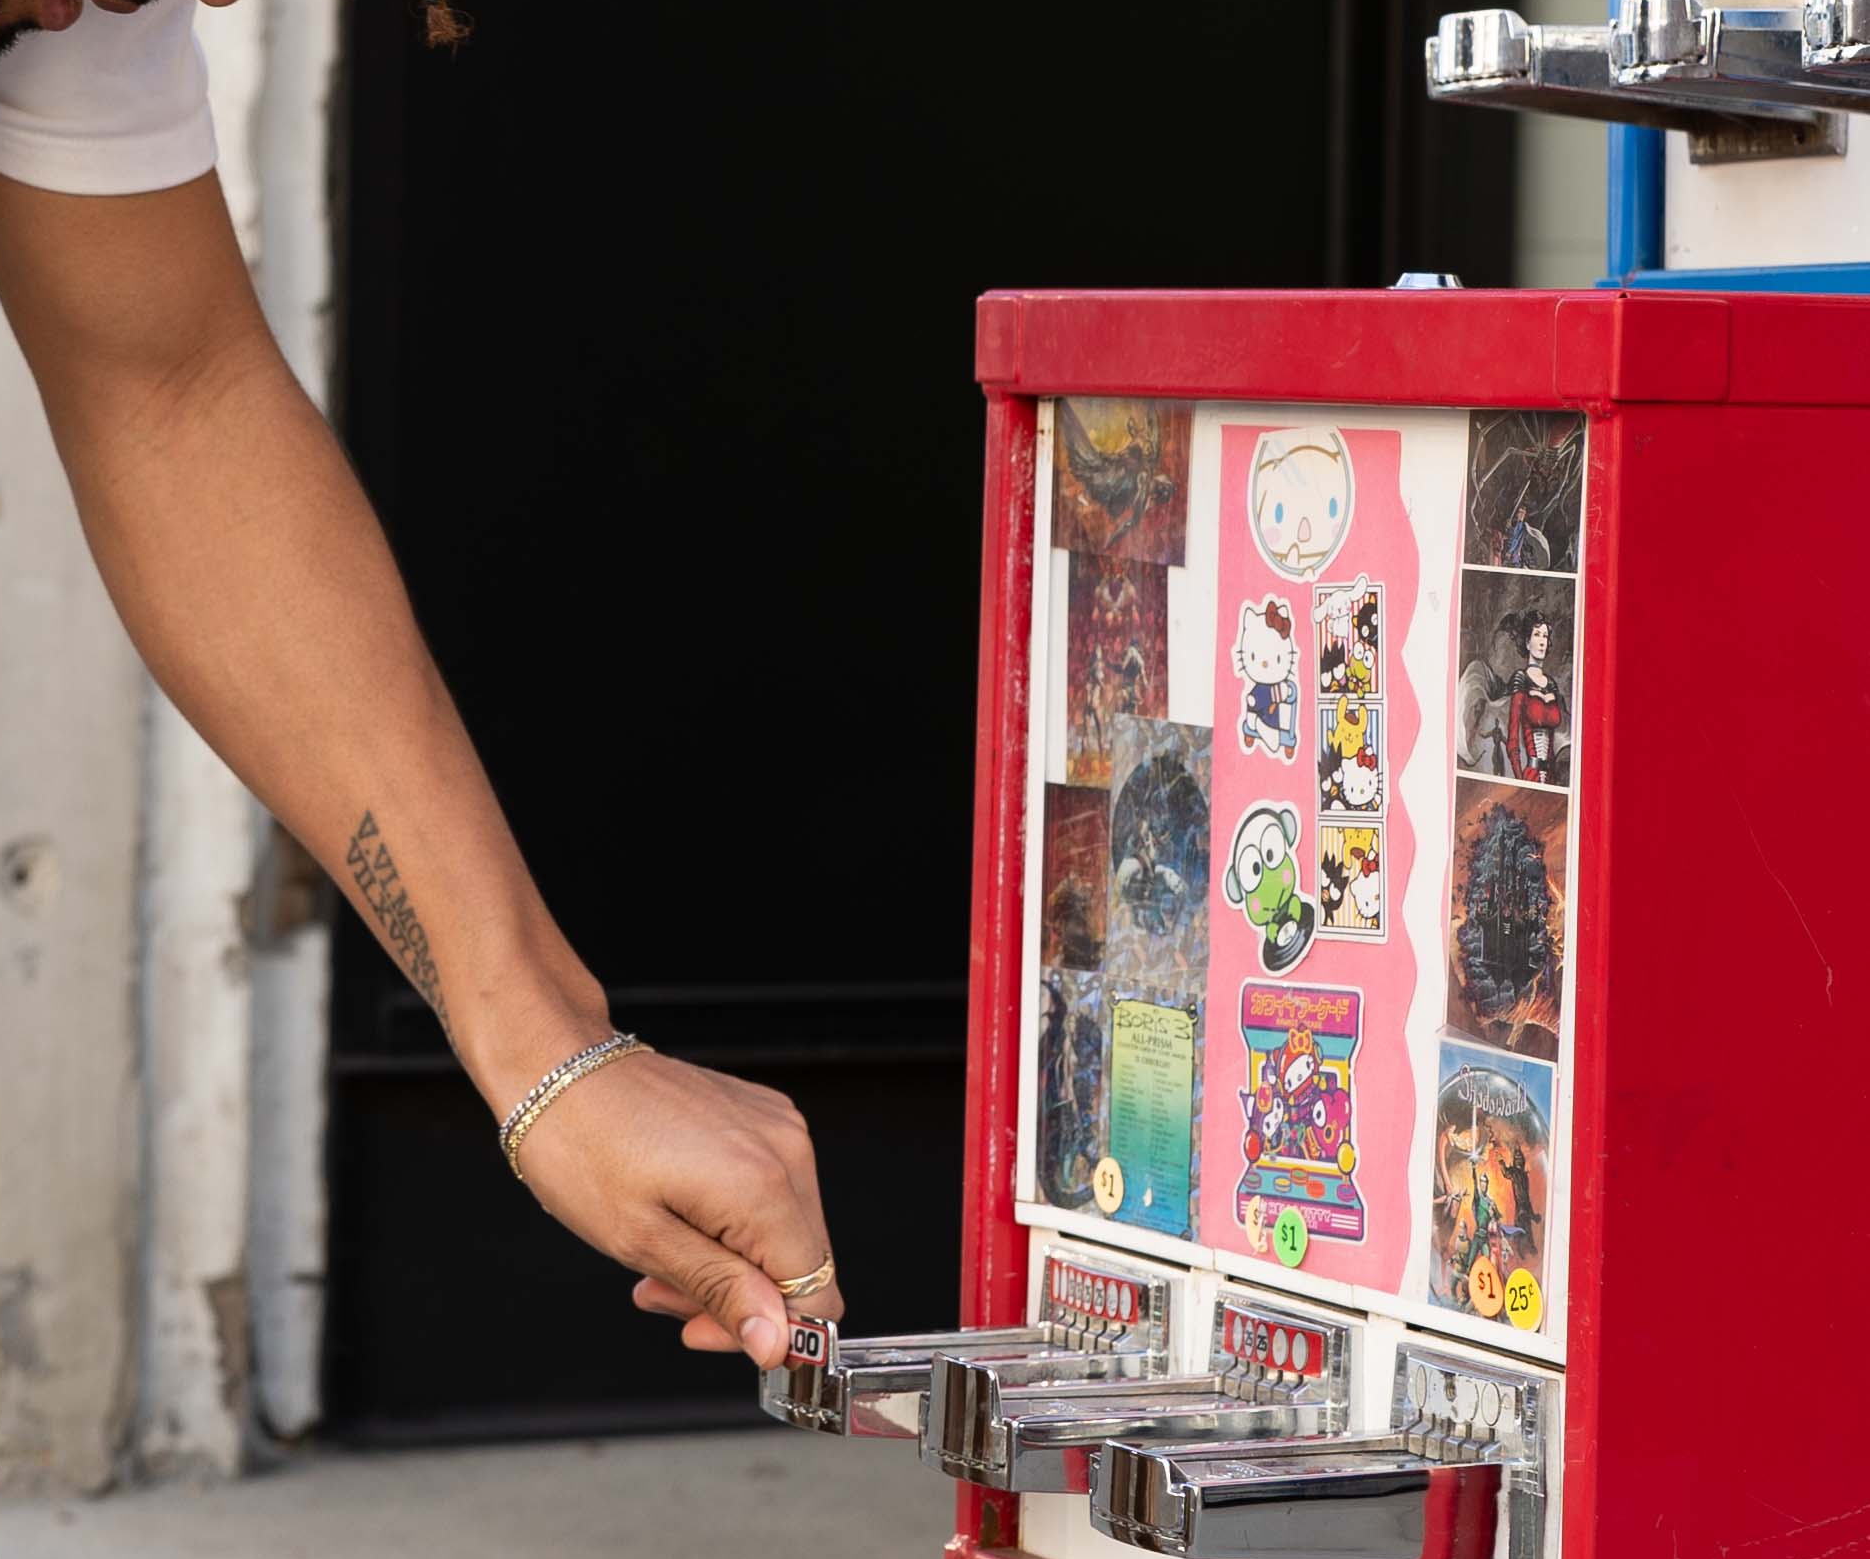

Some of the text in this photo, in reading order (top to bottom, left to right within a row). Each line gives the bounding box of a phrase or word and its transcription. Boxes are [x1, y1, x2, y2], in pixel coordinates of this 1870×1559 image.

[1173, 1018, 1191, 1040] 3
[1101, 1170, 1115, 1198] $1
[1281, 1223, 1297, 1252] $1
[1477, 1271, 1496, 1299] $1
[1509, 1282, 1534, 1312] 25¢
